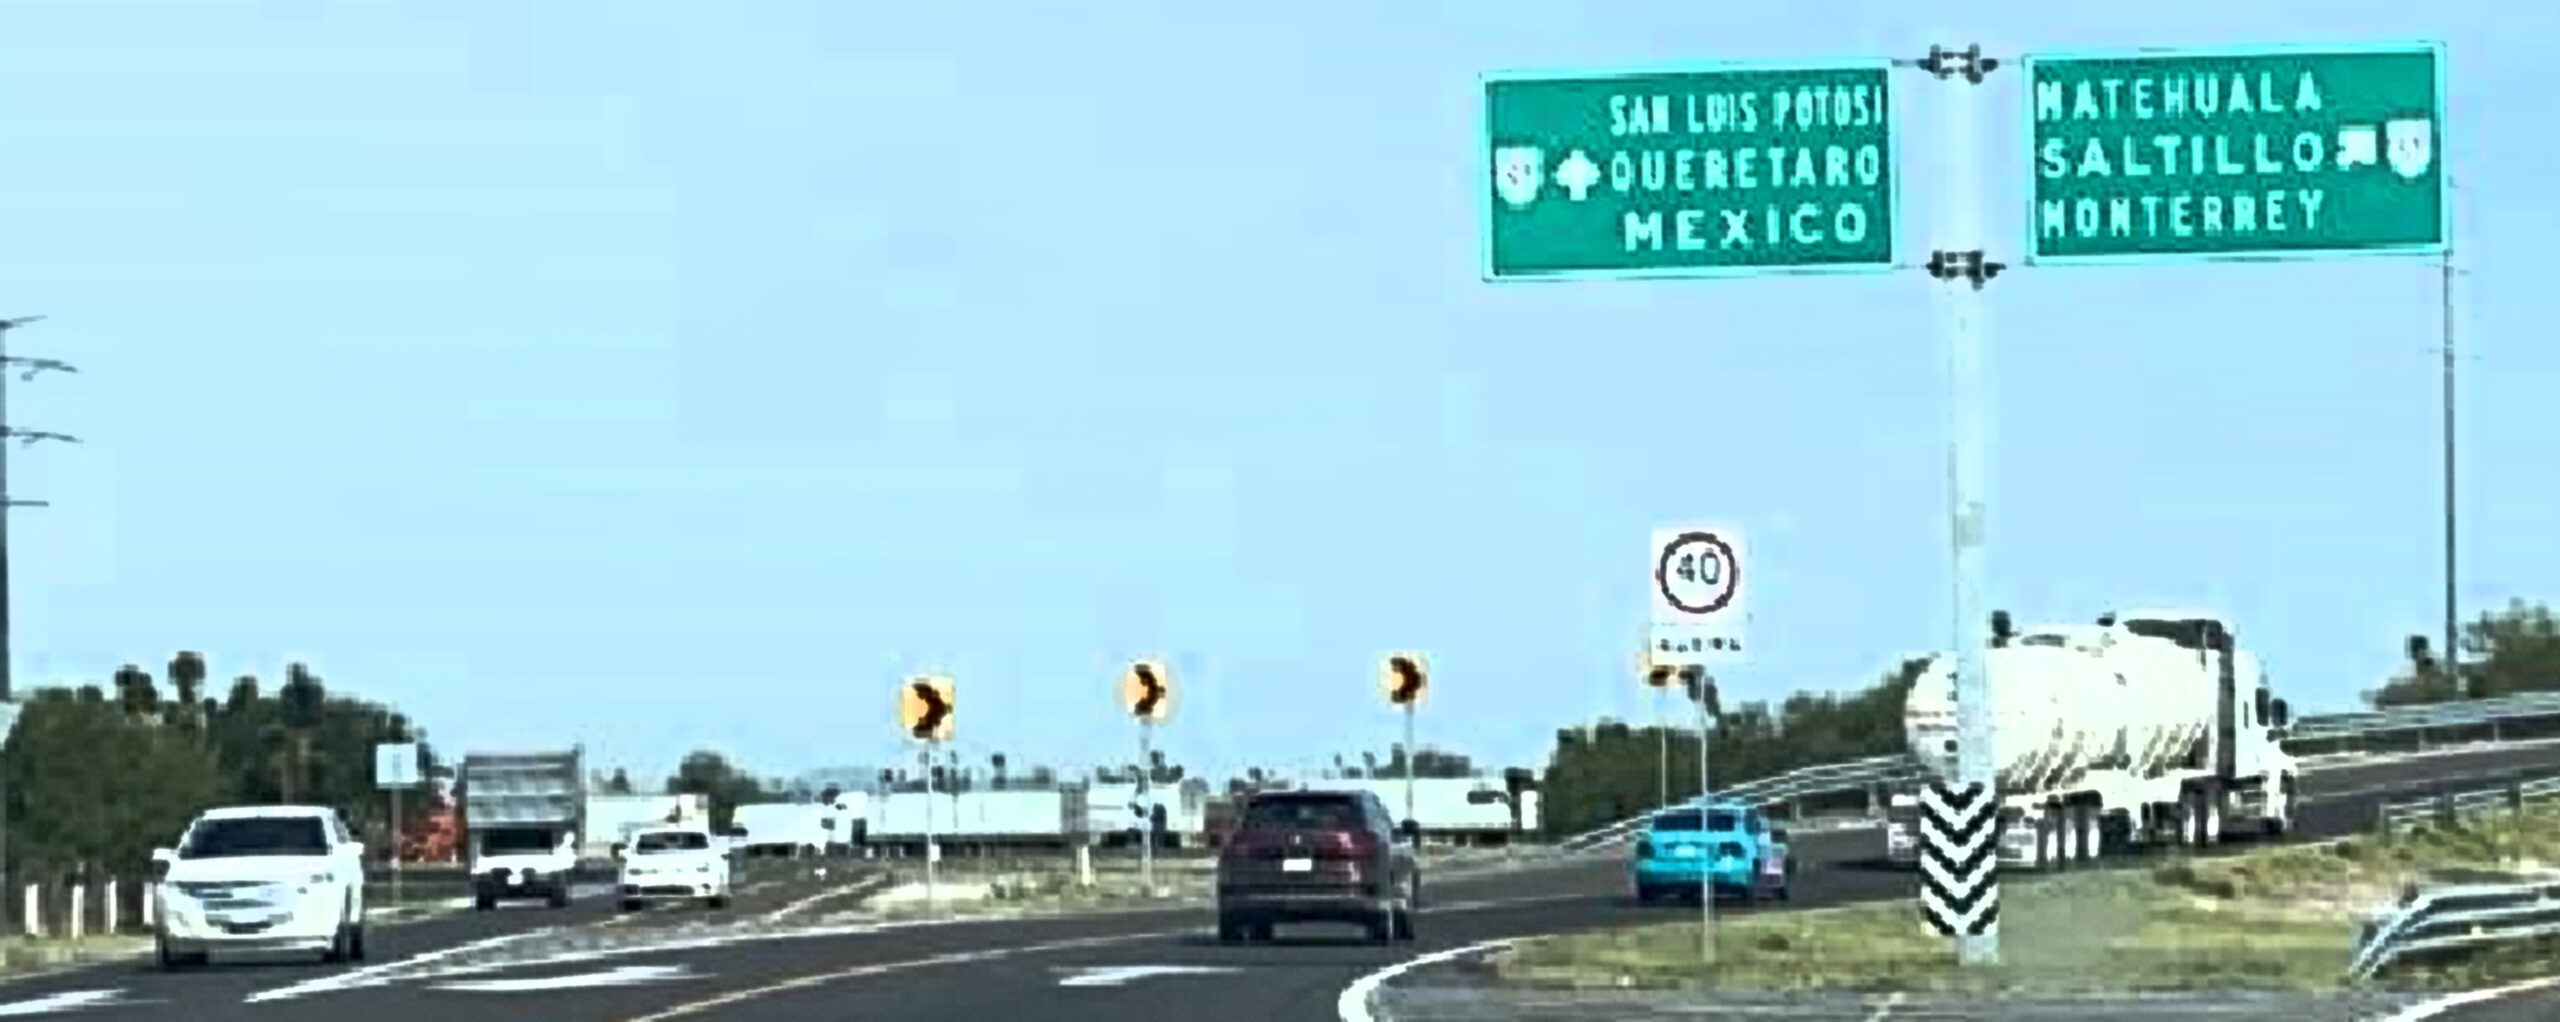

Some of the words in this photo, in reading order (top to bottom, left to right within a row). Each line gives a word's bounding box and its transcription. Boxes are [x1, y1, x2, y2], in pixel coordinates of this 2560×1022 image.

[1687, 91, 1756, 133] LUIS
[1772, 85, 1882, 131] POTOSI
[2037, 71, 2321, 120] MATEHUALA
[1611, 144, 1879, 190] QUERETARO
[2042, 132, 2324, 178] SALTILLO
[1625, 202, 1866, 251] MEXICO
[2042, 189, 2323, 237] MONTERREY
[1676, 550, 1720, 585] 40
